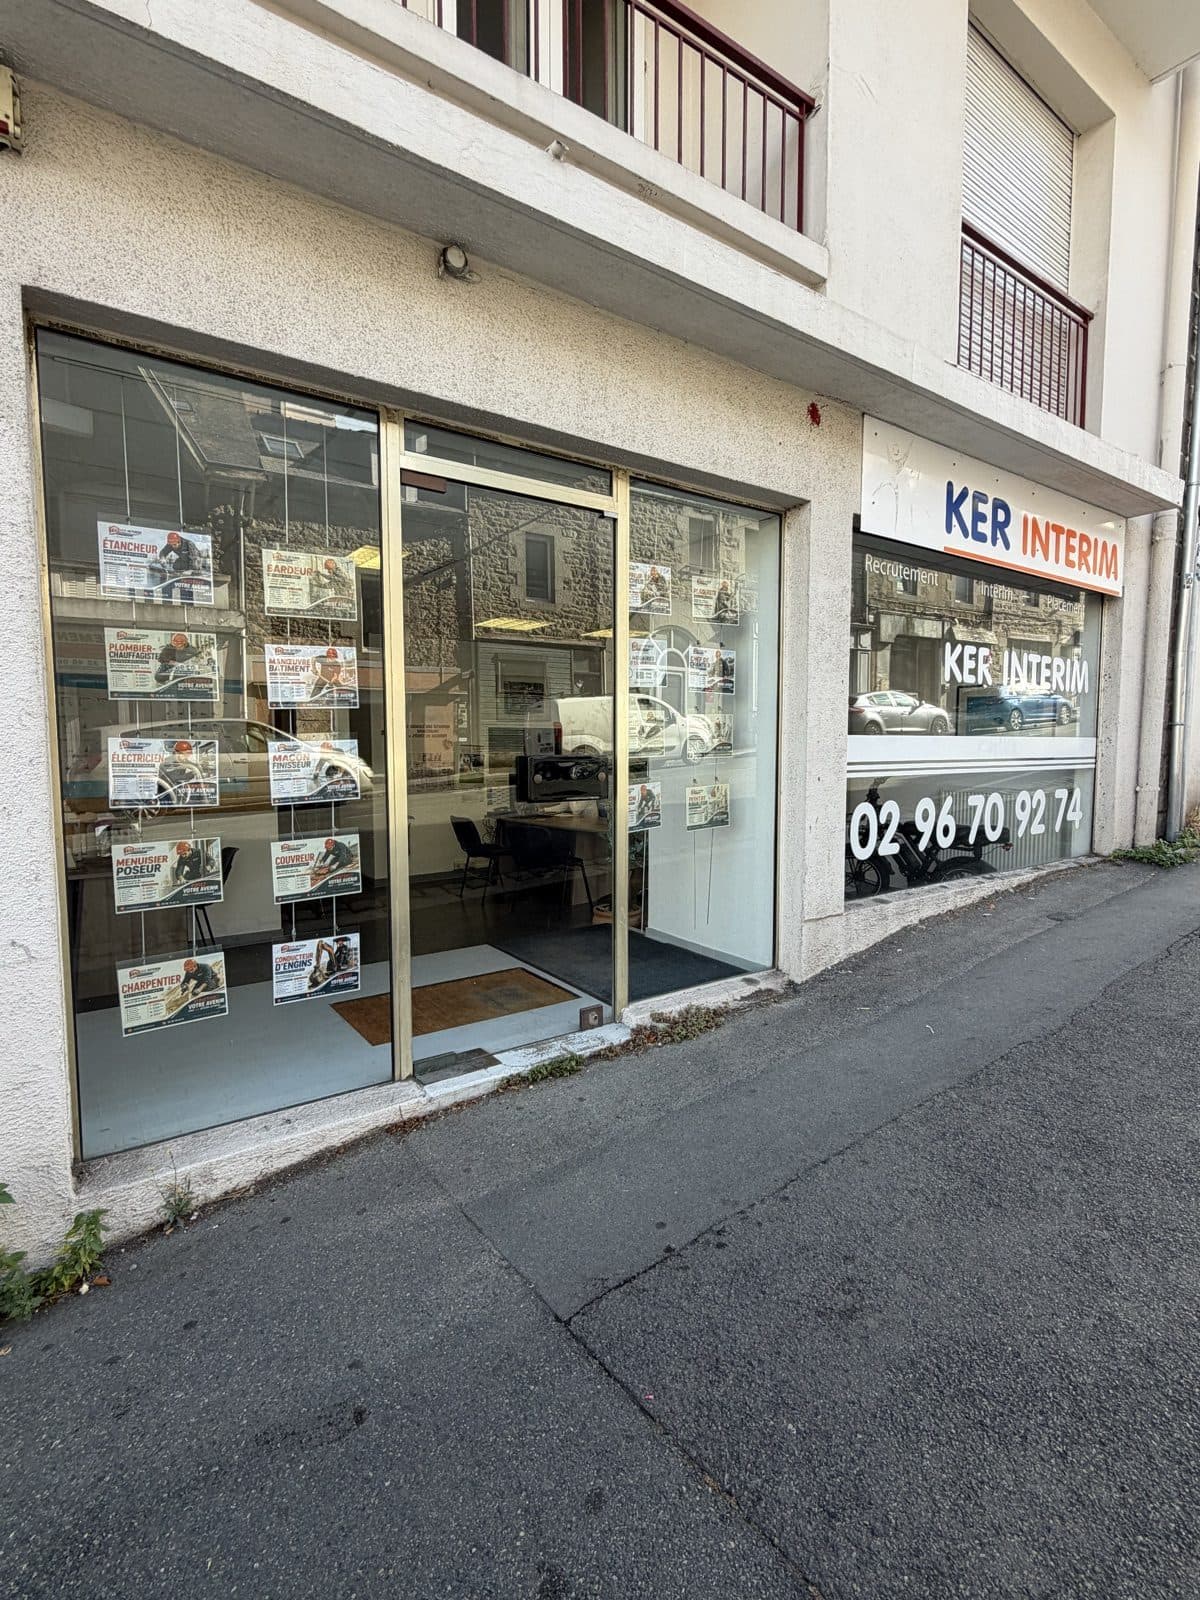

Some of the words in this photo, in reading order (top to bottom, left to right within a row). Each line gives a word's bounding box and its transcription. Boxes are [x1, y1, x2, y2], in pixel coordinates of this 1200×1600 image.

[945, 480, 1012, 551] KER
[1021, 513, 1119, 581] INTERIM
[103, 537, 158, 555] ÉTANCHEUR
[865, 553, 939, 586] Recrutement
[109, 651, 159, 660] CHAUFFAGISTE
[944, 641, 993, 686] KER
[1003, 650, 1089, 694] INTERIM
[112, 753, 164, 763] ÉLECTRICIEN
[272, 761, 311, 769] FINISSEUR
[850, 800, 901, 861] 02
[915, 795, 957, 852] 96
[968, 792, 1005, 845] 70
[1015, 788, 1046, 838] 92
[1055, 787, 1083, 833] 74
[116, 855, 169, 867] MENUISIER
[275, 853, 315, 865] COUVREUR
[116, 864, 162, 876] POSEUR
[275, 952, 313, 963] CONDUCTEUR
[275, 959, 313, 971] D'ENGINS
[121, 974, 181, 994] CHARPENTIER
